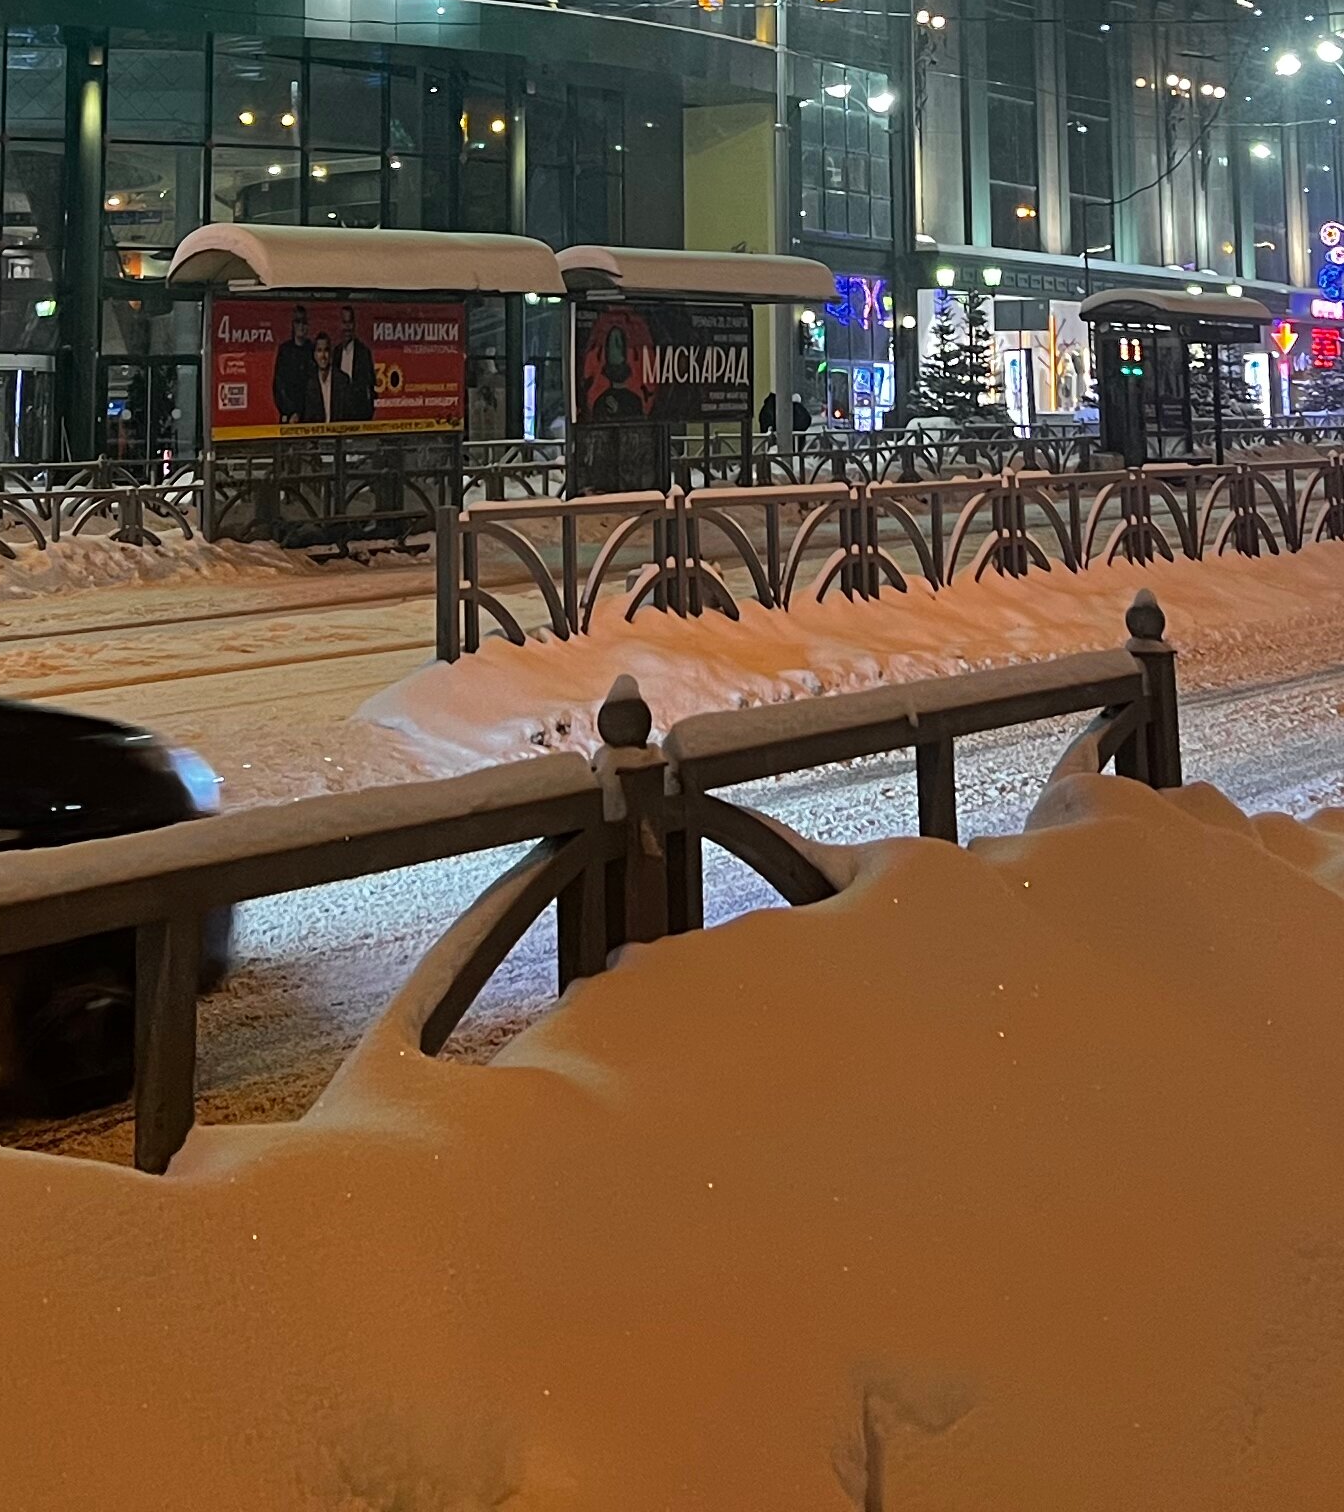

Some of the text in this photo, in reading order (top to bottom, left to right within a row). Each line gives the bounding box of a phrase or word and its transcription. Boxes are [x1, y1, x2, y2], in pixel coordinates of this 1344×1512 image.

[218, 315, 274, 343] 4 МАРТА
[373, 322, 459, 341] ИВАНУШКИ
[642, 345, 749, 386] МАСКАРАД
